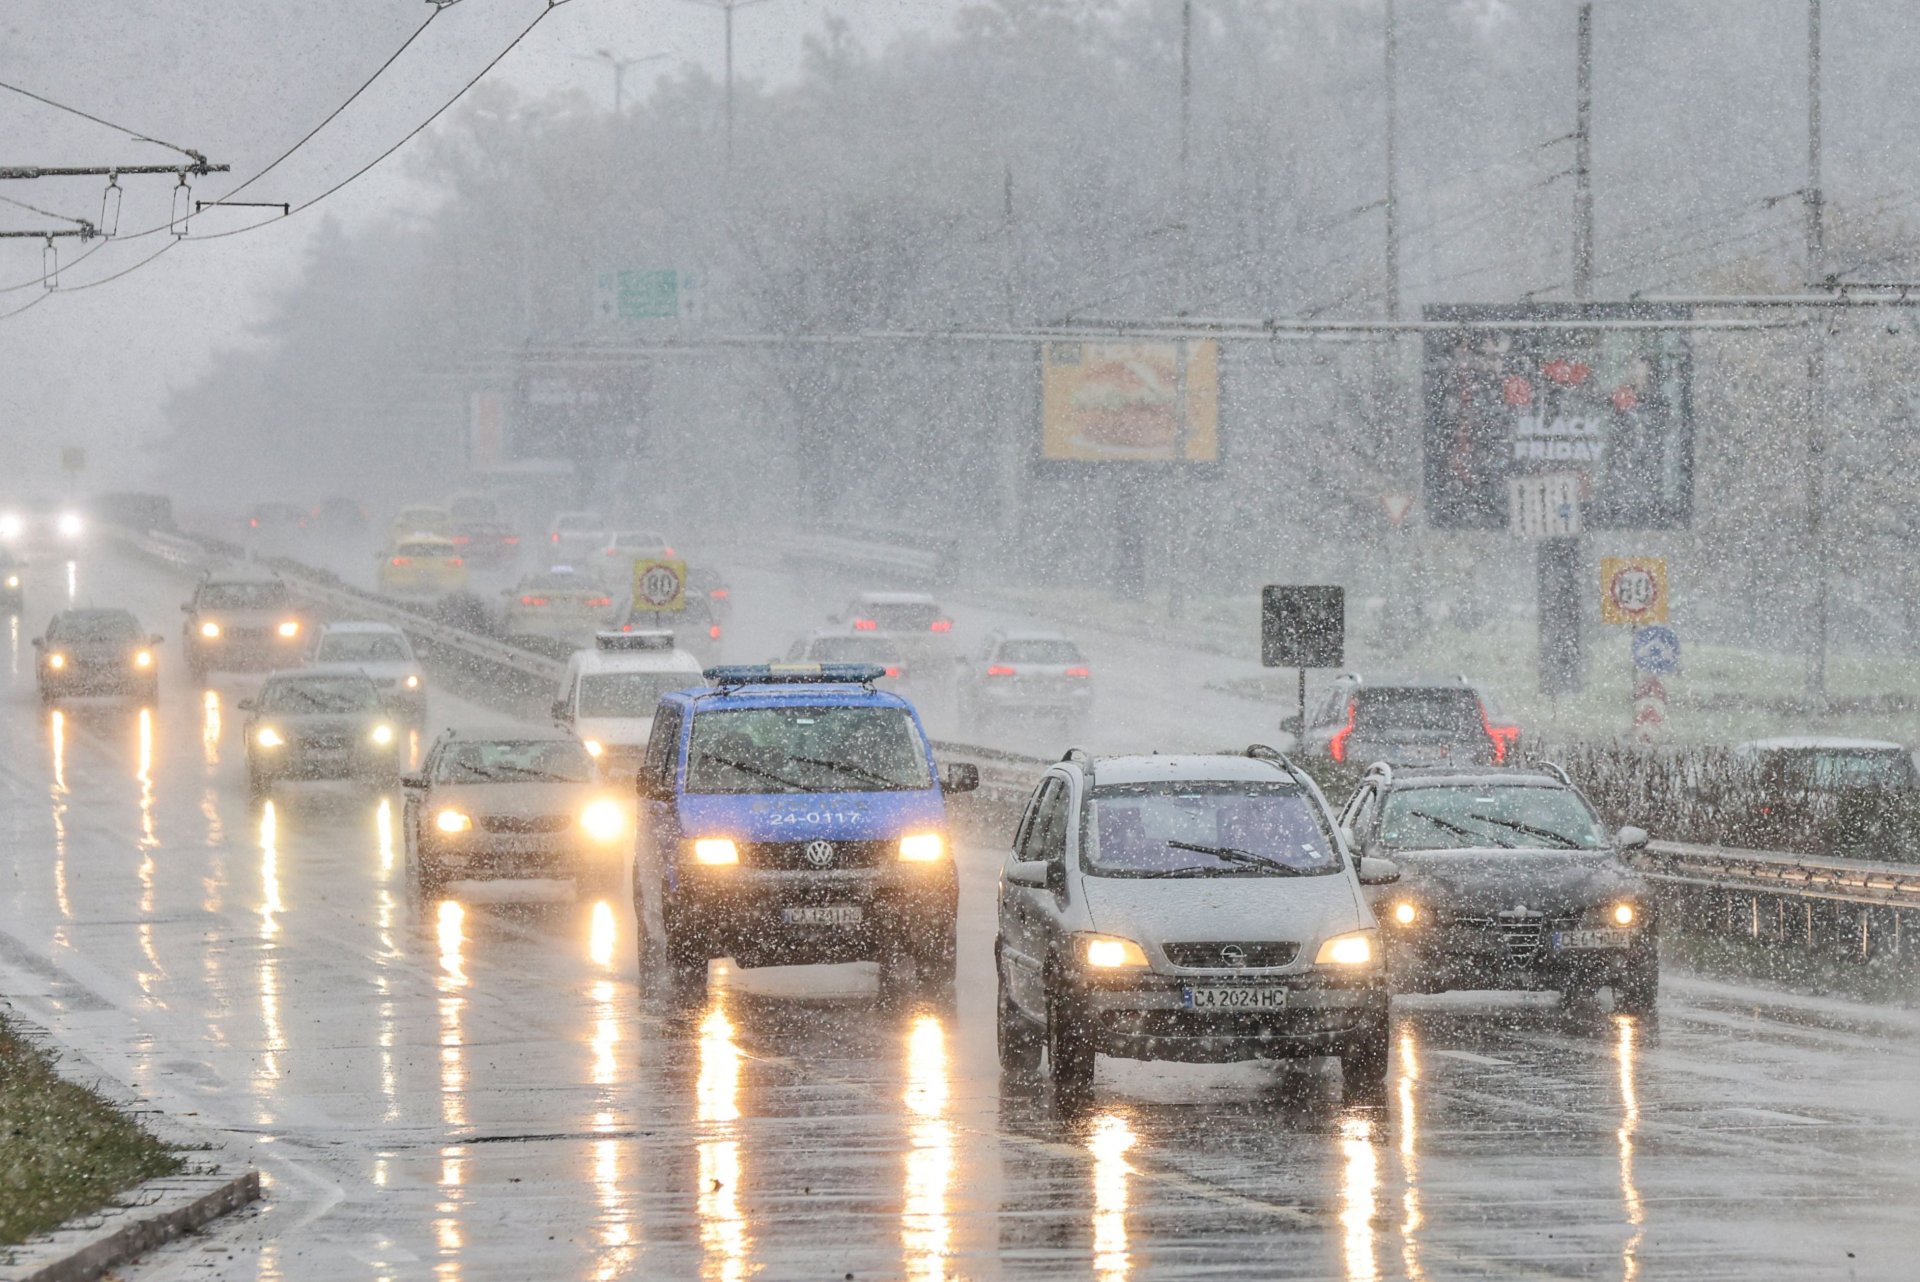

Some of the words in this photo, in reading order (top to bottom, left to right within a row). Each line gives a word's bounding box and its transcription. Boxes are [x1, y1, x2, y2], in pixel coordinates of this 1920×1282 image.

[1517, 416, 1600, 436] BLACK
[1514, 440, 1605, 461] FRIDAY
[647, 574, 672, 597] 80
[769, 812, 862, 825] 24-0117
